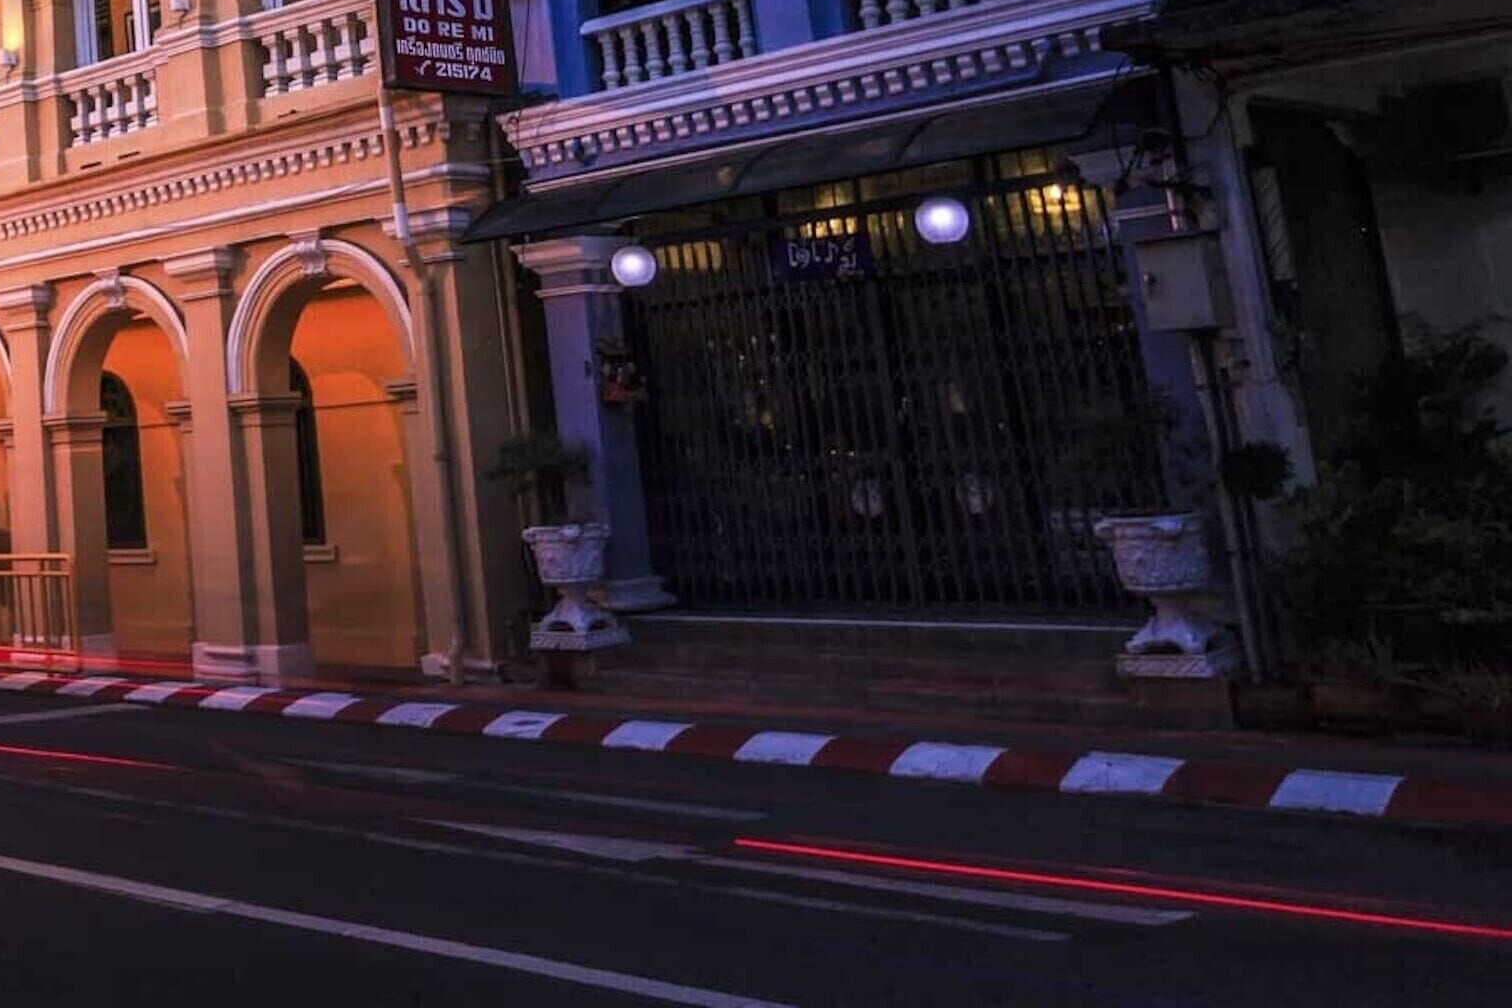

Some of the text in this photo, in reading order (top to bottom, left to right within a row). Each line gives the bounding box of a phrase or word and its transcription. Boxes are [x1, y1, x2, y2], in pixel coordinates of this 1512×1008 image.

[403, 17, 494, 42] DO RE MI
[435, 61, 492, 82] 215174
